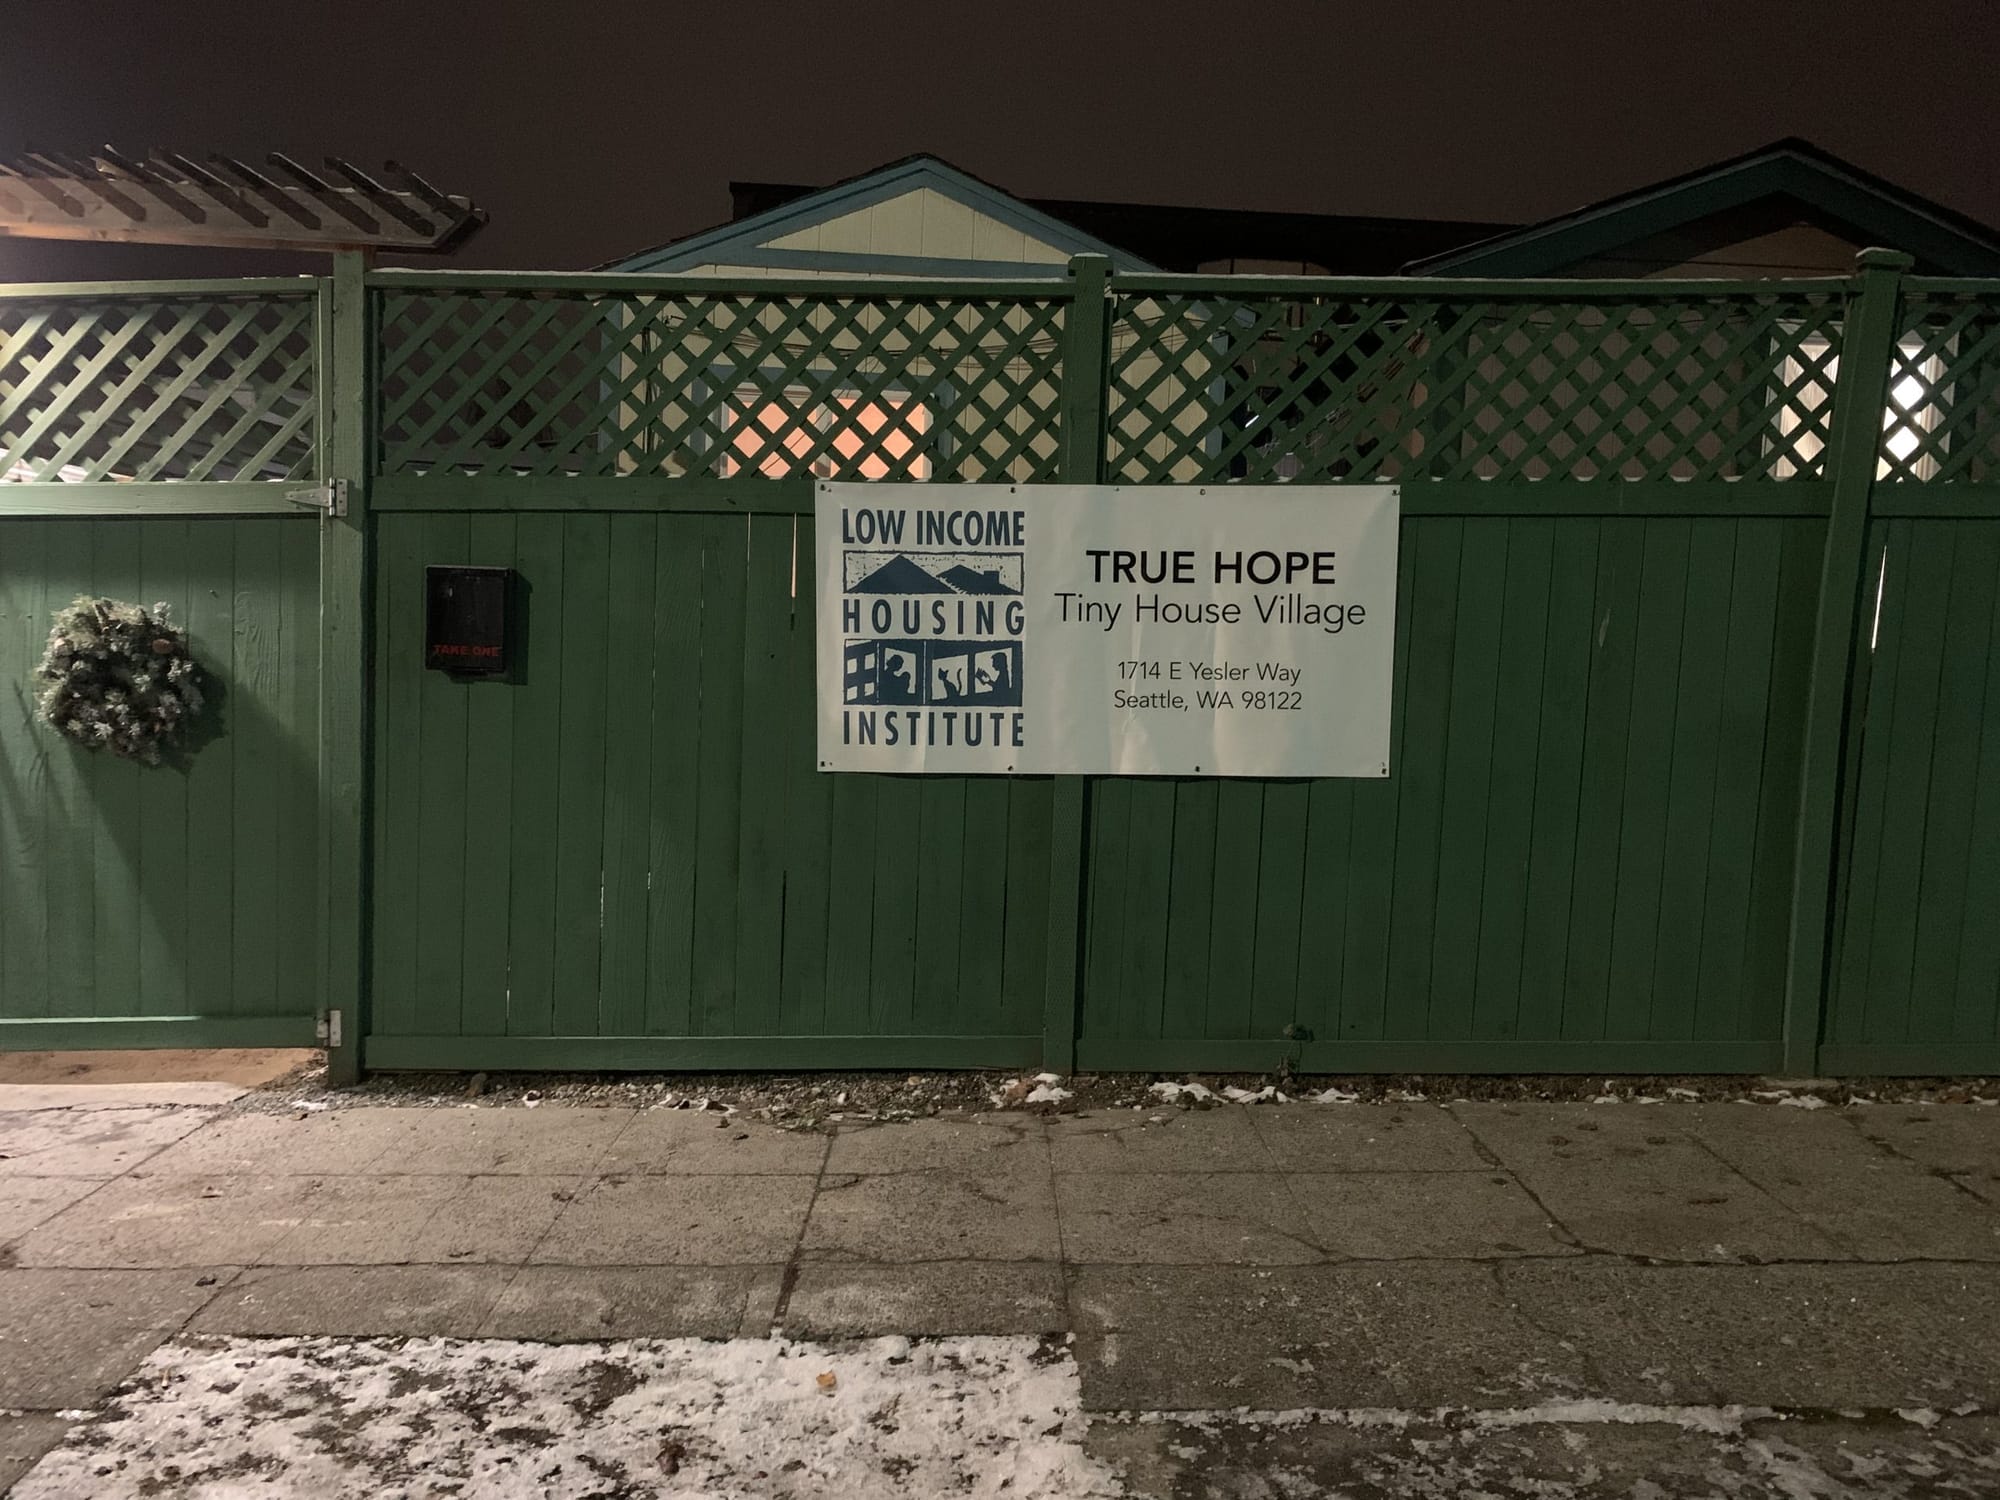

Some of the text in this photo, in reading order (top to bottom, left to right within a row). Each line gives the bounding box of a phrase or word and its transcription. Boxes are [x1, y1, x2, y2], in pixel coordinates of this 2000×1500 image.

[842, 508, 1025, 547] LOW INCOME
[1085, 549, 1336, 586] TRUE HOPE
[843, 598, 1025, 636] HOUSING
[1053, 592, 1367, 635] Tiny House Village
[432, 644, 502, 657] TAKE ONE
[1117, 660, 1302, 688] 1714 E Yesler Way
[1113, 689, 1303, 713] Seattle, WA 98122
[843, 710, 1025, 748] INSTITUTE
